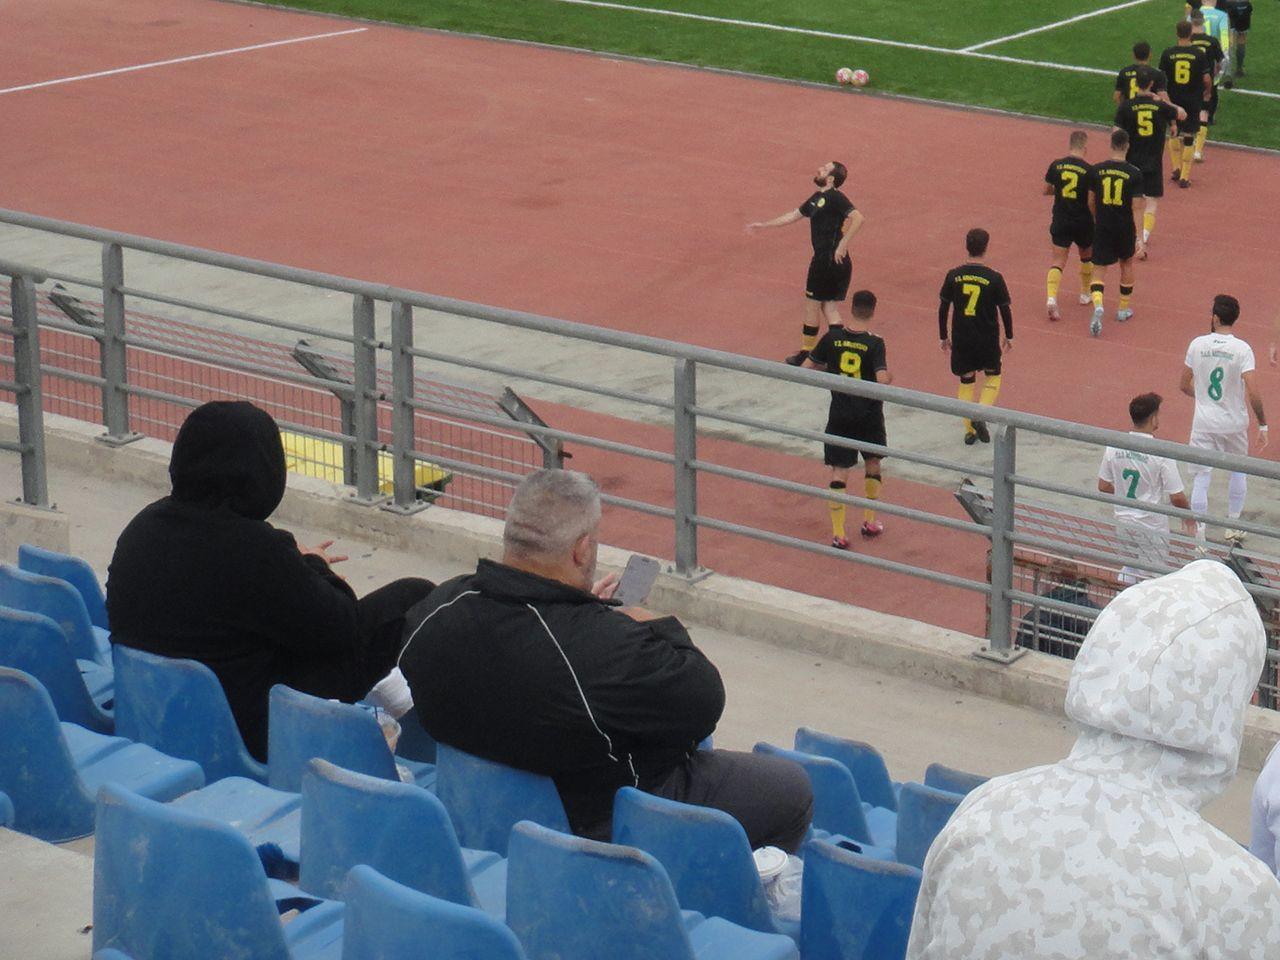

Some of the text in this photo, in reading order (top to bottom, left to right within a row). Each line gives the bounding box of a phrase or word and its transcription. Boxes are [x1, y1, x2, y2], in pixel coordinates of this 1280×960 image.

[1174, 60, 1191, 84] 6
[1137, 111, 1154, 137] 5
[1061, 170, 1078, 199] 2
[1102, 176, 1124, 206] 11
[962, 283, 981, 316] 7
[840, 350, 862, 380] 9
[1207, 366, 1225, 401] 8
[1122, 467, 1141, 500] 7
